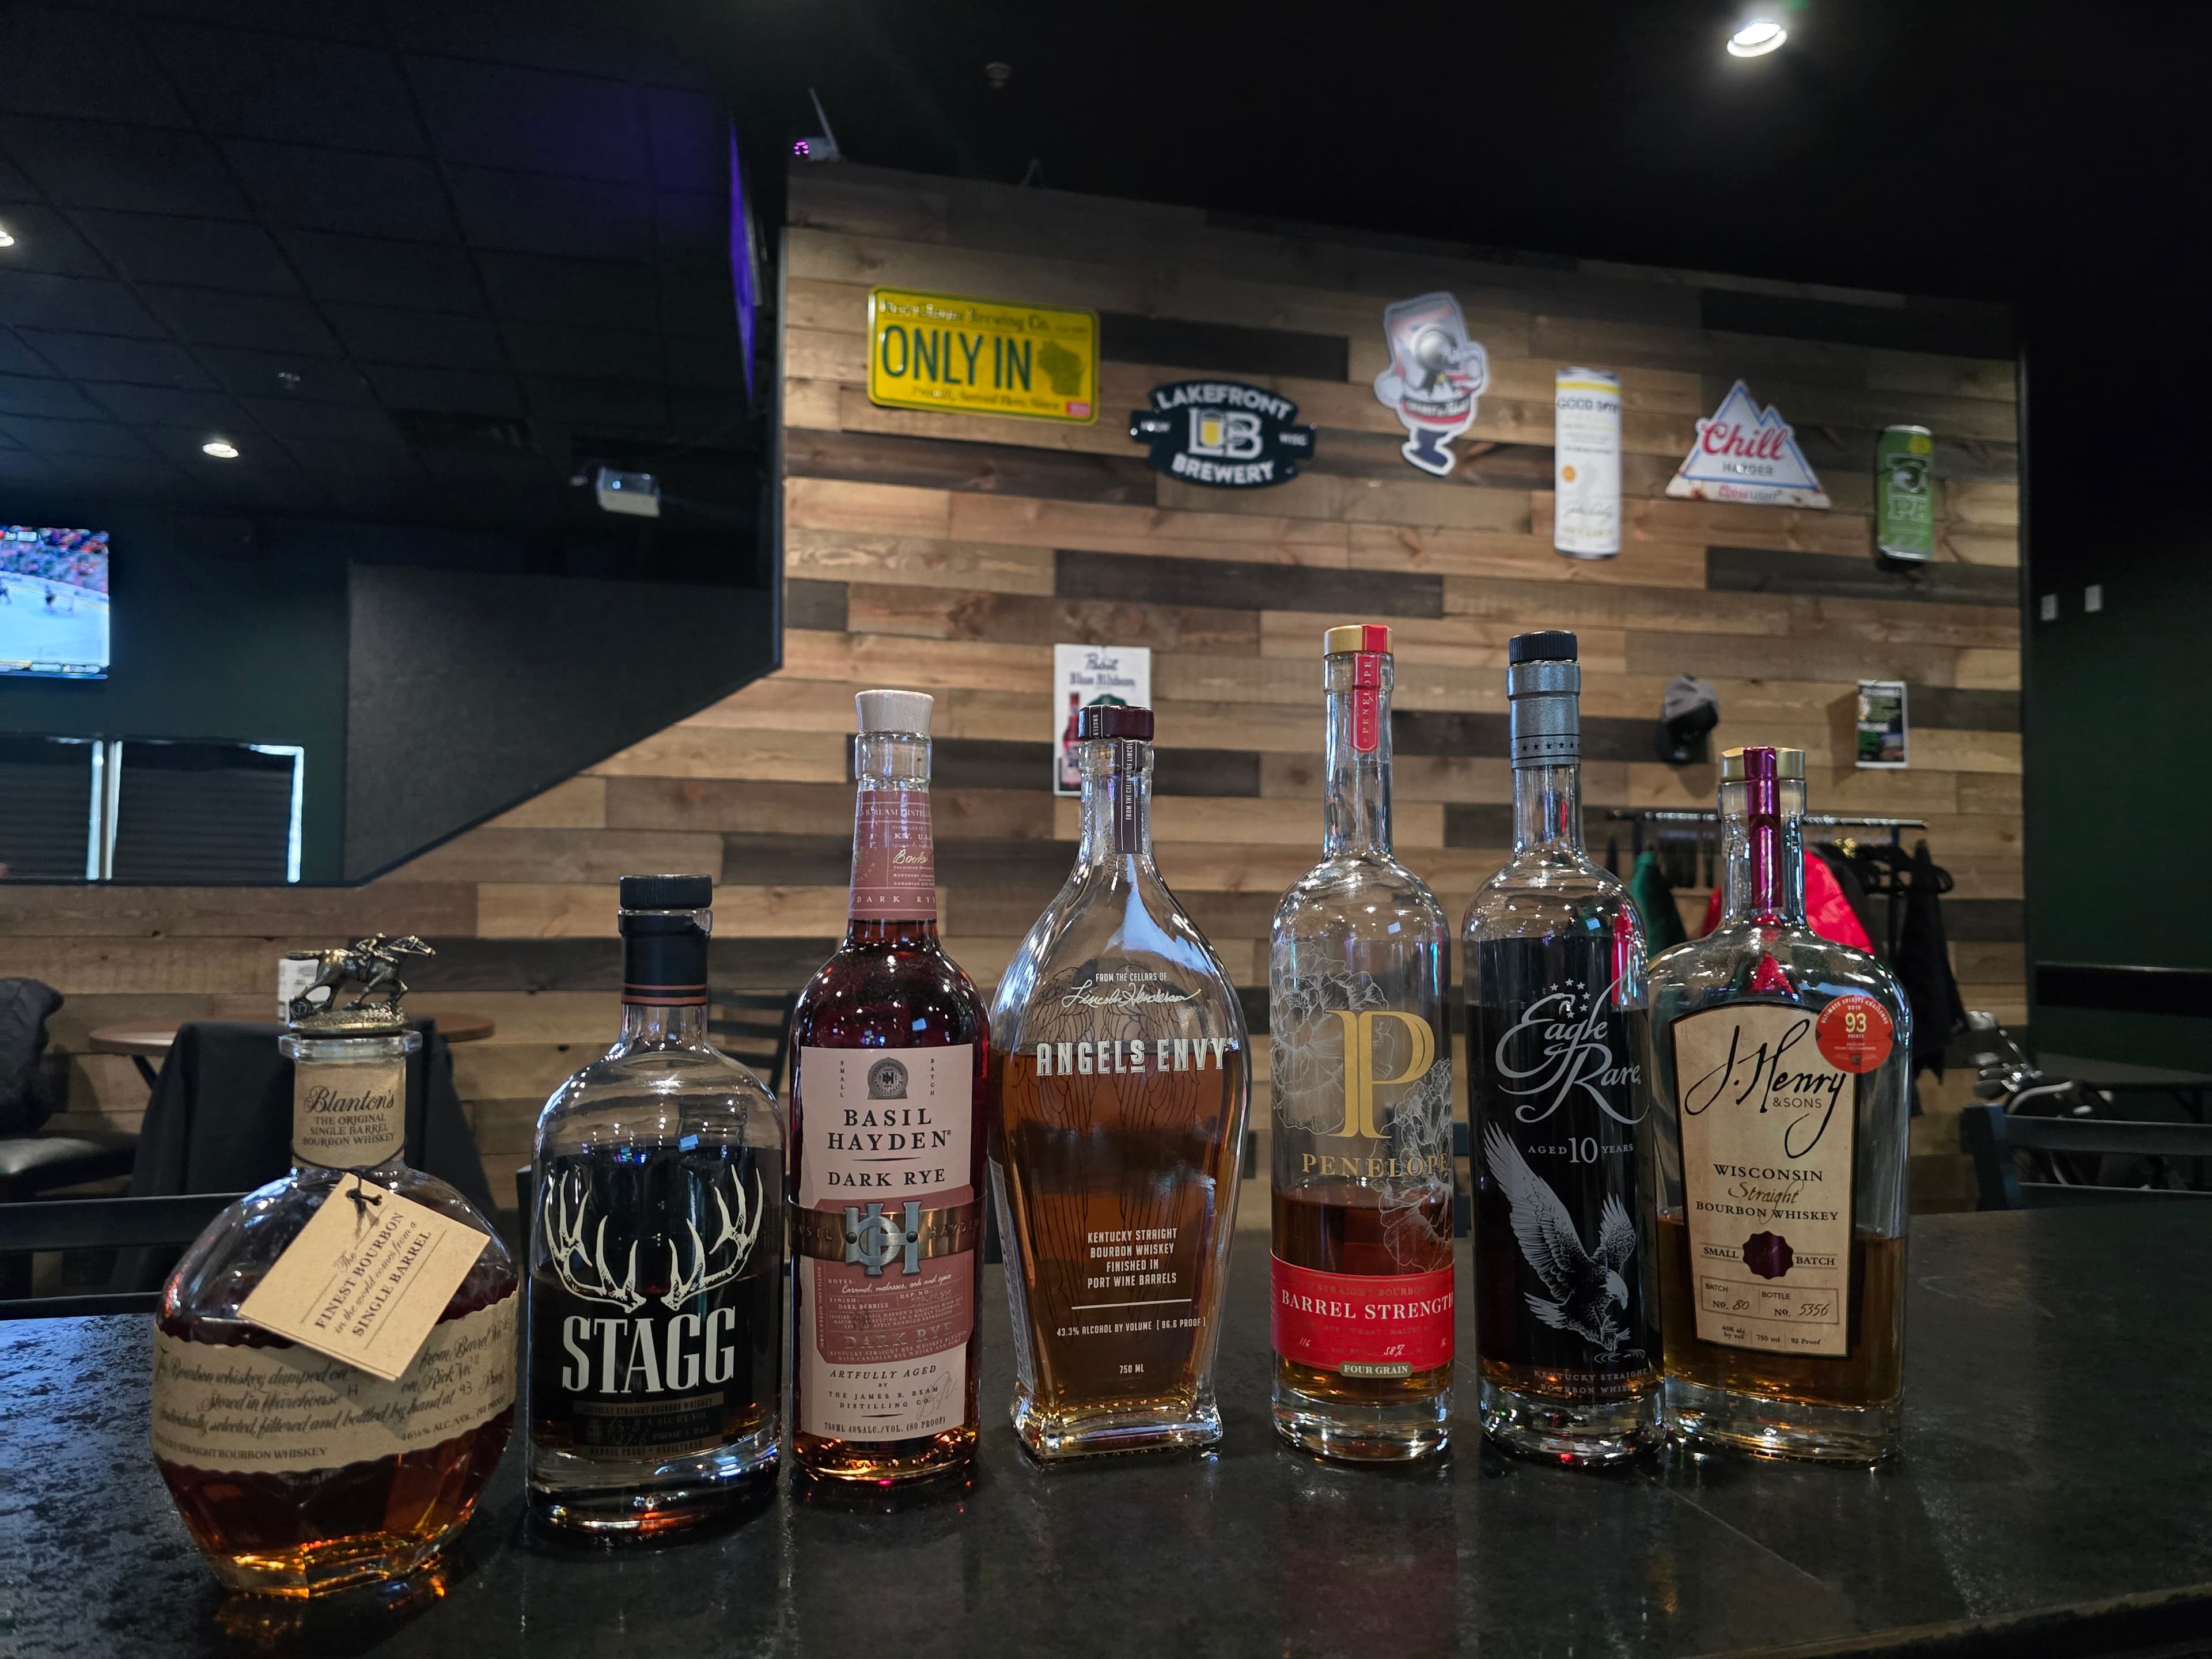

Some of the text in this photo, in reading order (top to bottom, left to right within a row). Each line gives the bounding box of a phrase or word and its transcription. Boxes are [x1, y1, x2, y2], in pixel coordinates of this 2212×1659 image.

[882, 324, 1032, 392] ONLY IN
[1156, 382, 1293, 421] LAKEFRONT
[1699, 421, 1788, 460] Chill
[1171, 452, 1275, 485] BREWERY
[1096, 972, 1167, 982] FROM THE CELLARS OF
[1844, 1012, 1867, 1033] 93
[1324, 1009, 1435, 1139] P
[1736, 1018, 1847, 1159] Henry
[303, 1085, 395, 1113] Blanton's
[316, 1113, 386, 1125] THE ORIGINAL
[843, 1108, 932, 1127] BASIL
[310, 1123, 389, 1135] SINGLE BARREL
[303, 1132, 395, 1147] BOURBON WHISKEY
[1528, 1137, 1634, 1164] AGED 10 YEARS
[1302, 1152, 1448, 1178] PENELOPE
[1713, 1164, 1823, 1182] WISCONSIN
[828, 1168, 945, 1187] DARK RYE
[1695, 1200, 1839, 1221] BOURBON WHISKEY
[1728, 1179, 1805, 1225] Straight
[1088, 1228, 1177, 1244] KENTUCKY STRAIGHT
[1090, 1243, 1175, 1259] BOURBON WHISKEY
[1703, 1246, 1740, 1259] SMALL
[336, 1246, 358, 1274] The
[1107, 1259, 1159, 1272] FINISHED IN
[1795, 1256, 1835, 1266] BATCH
[315, 1212, 405, 1330] FINEST BOURBON
[353, 1231, 431, 1337] SINGLE BARREL
[1088, 1272, 1177, 1289] PORT WINE BARRELS
[1705, 1283, 1728, 1293] BATCH
[1762, 1291, 1791, 1300] BOTTLE
[1282, 1289, 1454, 1320] BARREL STRENGTH
[1732, 1299, 1750, 1310] 80
[1798, 1303, 1830, 1317] 5356
[844, 1321, 953, 1349] DARK RYE
[1056, 1317, 1202, 1336] 43.3% ALCOHOL BY VOLUME 86.6 PROOF
[562, 1305, 736, 1394] STAGG
[1801, 1338, 1821, 1346] Proof
[215, 1365, 265, 1388] whiskey
[830, 1365, 937, 1380] ARTFULLY AGED
[1119, 1363, 1145, 1374] 750 ML
[1344, 1364, 1408, 1374] FOUR GRAIN
[1601, 1368, 1648, 1381] STRAIGHT
[347, 1384, 358, 1396] H
[460, 1382, 473, 1396] 93
[912, 1386, 939, 1396] BEAM
[839, 1402, 908, 1410] DISTILLING
[824, 1422, 846, 1433] 750ML
[921, 1415, 946, 1429] PROOF)
[218, 1446, 328, 1460] BOURBON WHISKEY
